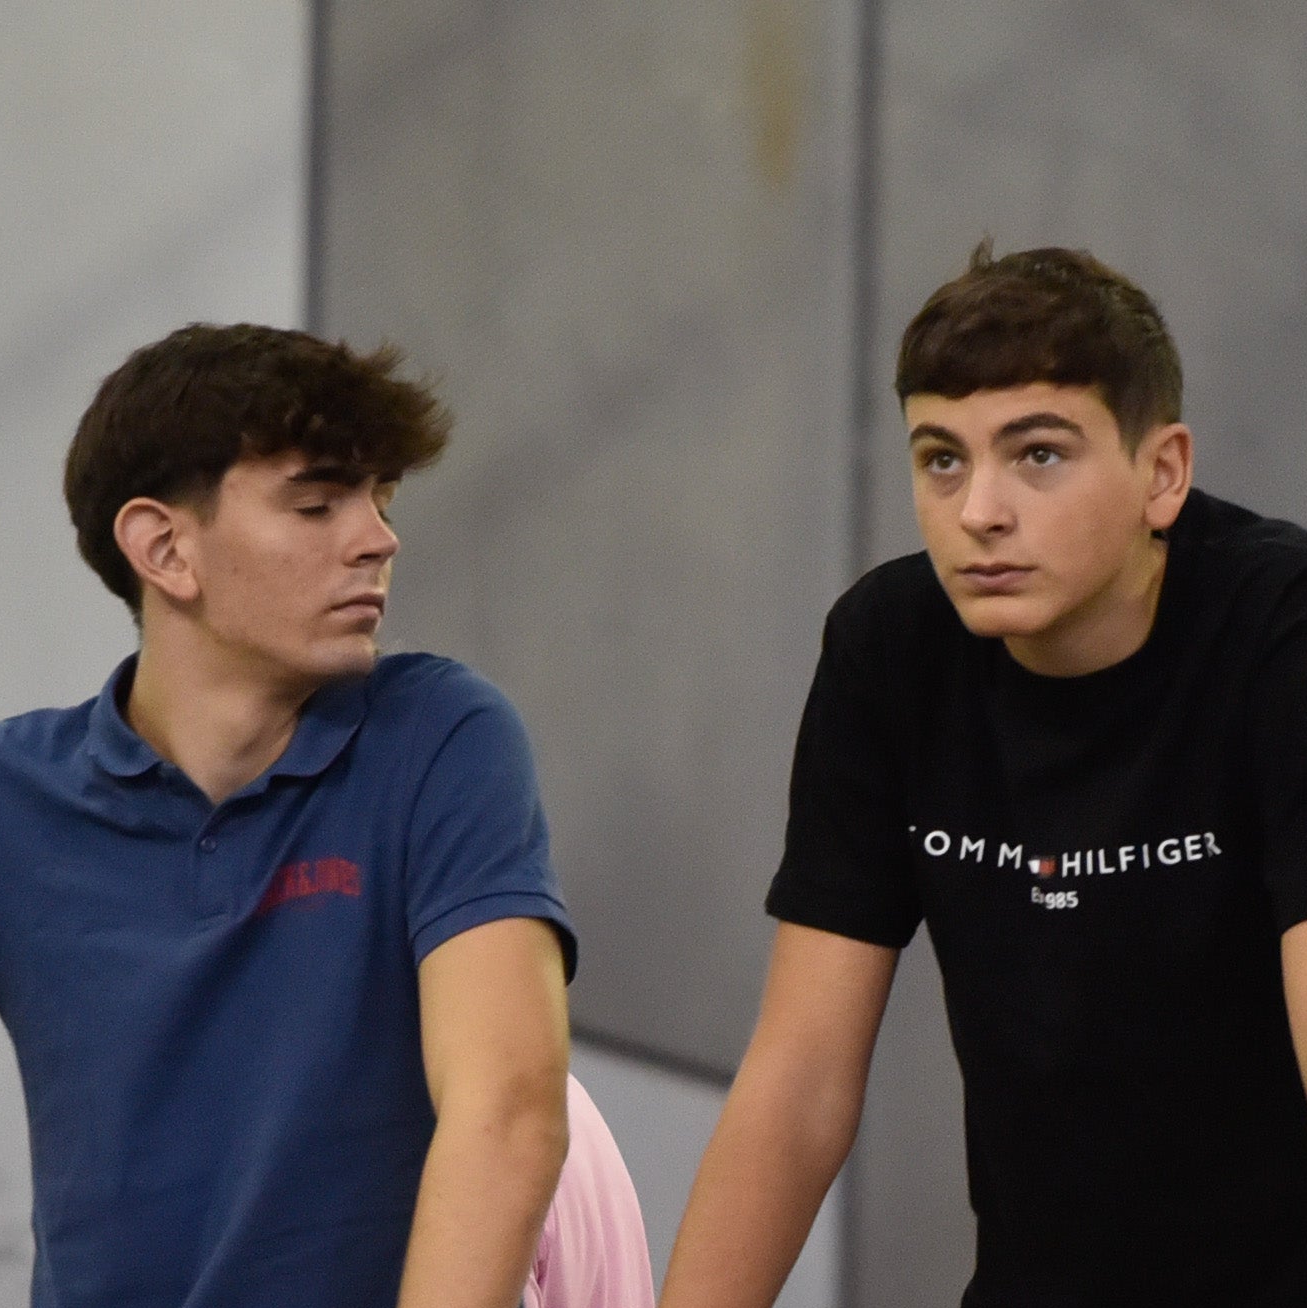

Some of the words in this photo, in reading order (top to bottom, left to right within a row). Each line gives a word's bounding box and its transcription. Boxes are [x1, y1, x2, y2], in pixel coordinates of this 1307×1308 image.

[907, 824, 1025, 871] OMM
[1060, 831, 1223, 879] HILFIGER
[1044, 890, 1079, 910] 985
